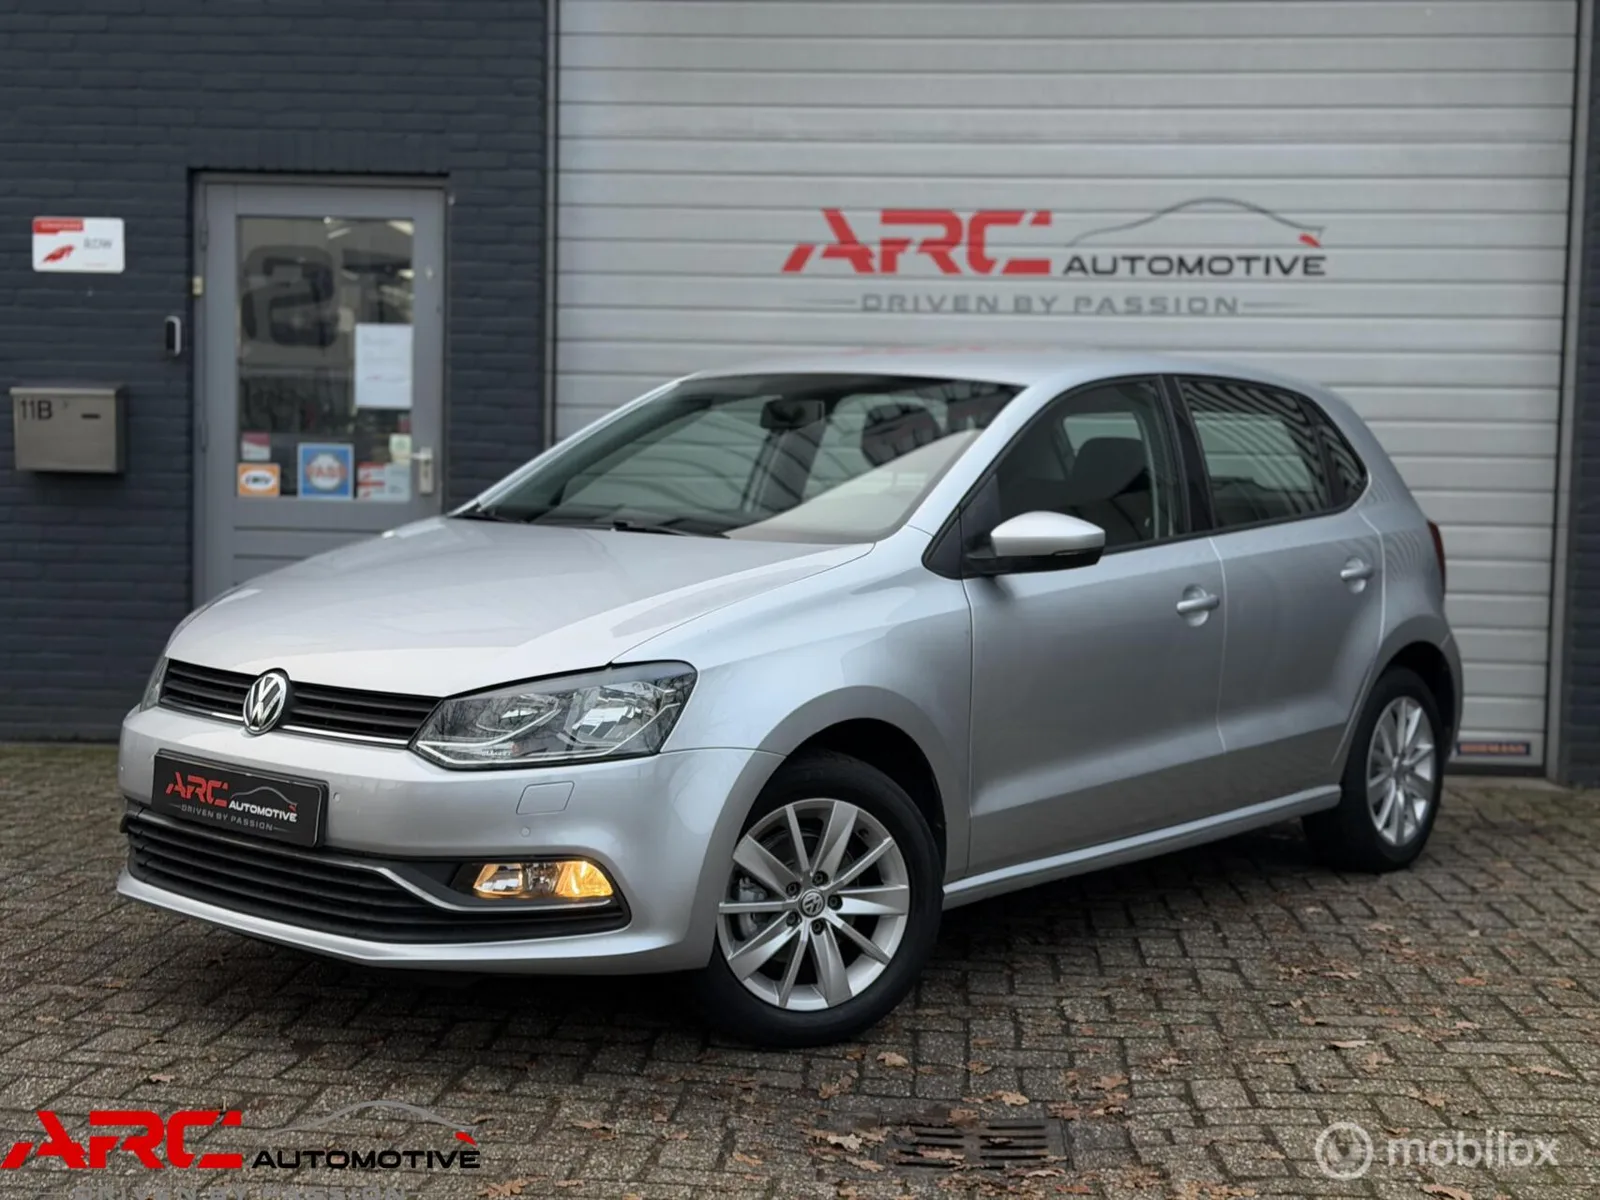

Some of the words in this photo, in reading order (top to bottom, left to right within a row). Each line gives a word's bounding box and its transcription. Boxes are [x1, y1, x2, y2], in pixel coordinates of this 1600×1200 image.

[782, 208, 1052, 275] ARC
[1063, 255, 1327, 277] AUTOMOTIVE
[861, 293, 999, 314] DRIVEN
[1013, 295, 1059, 314] BY
[1073, 296, 1239, 315] PASSION
[21, 399, 52, 420] 11B
[165, 771, 229, 808] ARC
[228, 800, 298, 823] AUTOMOTIVE
[181, 804, 214, 818] DRIVEN
[215, 812, 229, 822] BY
[230, 814, 274, 832] PASSION
